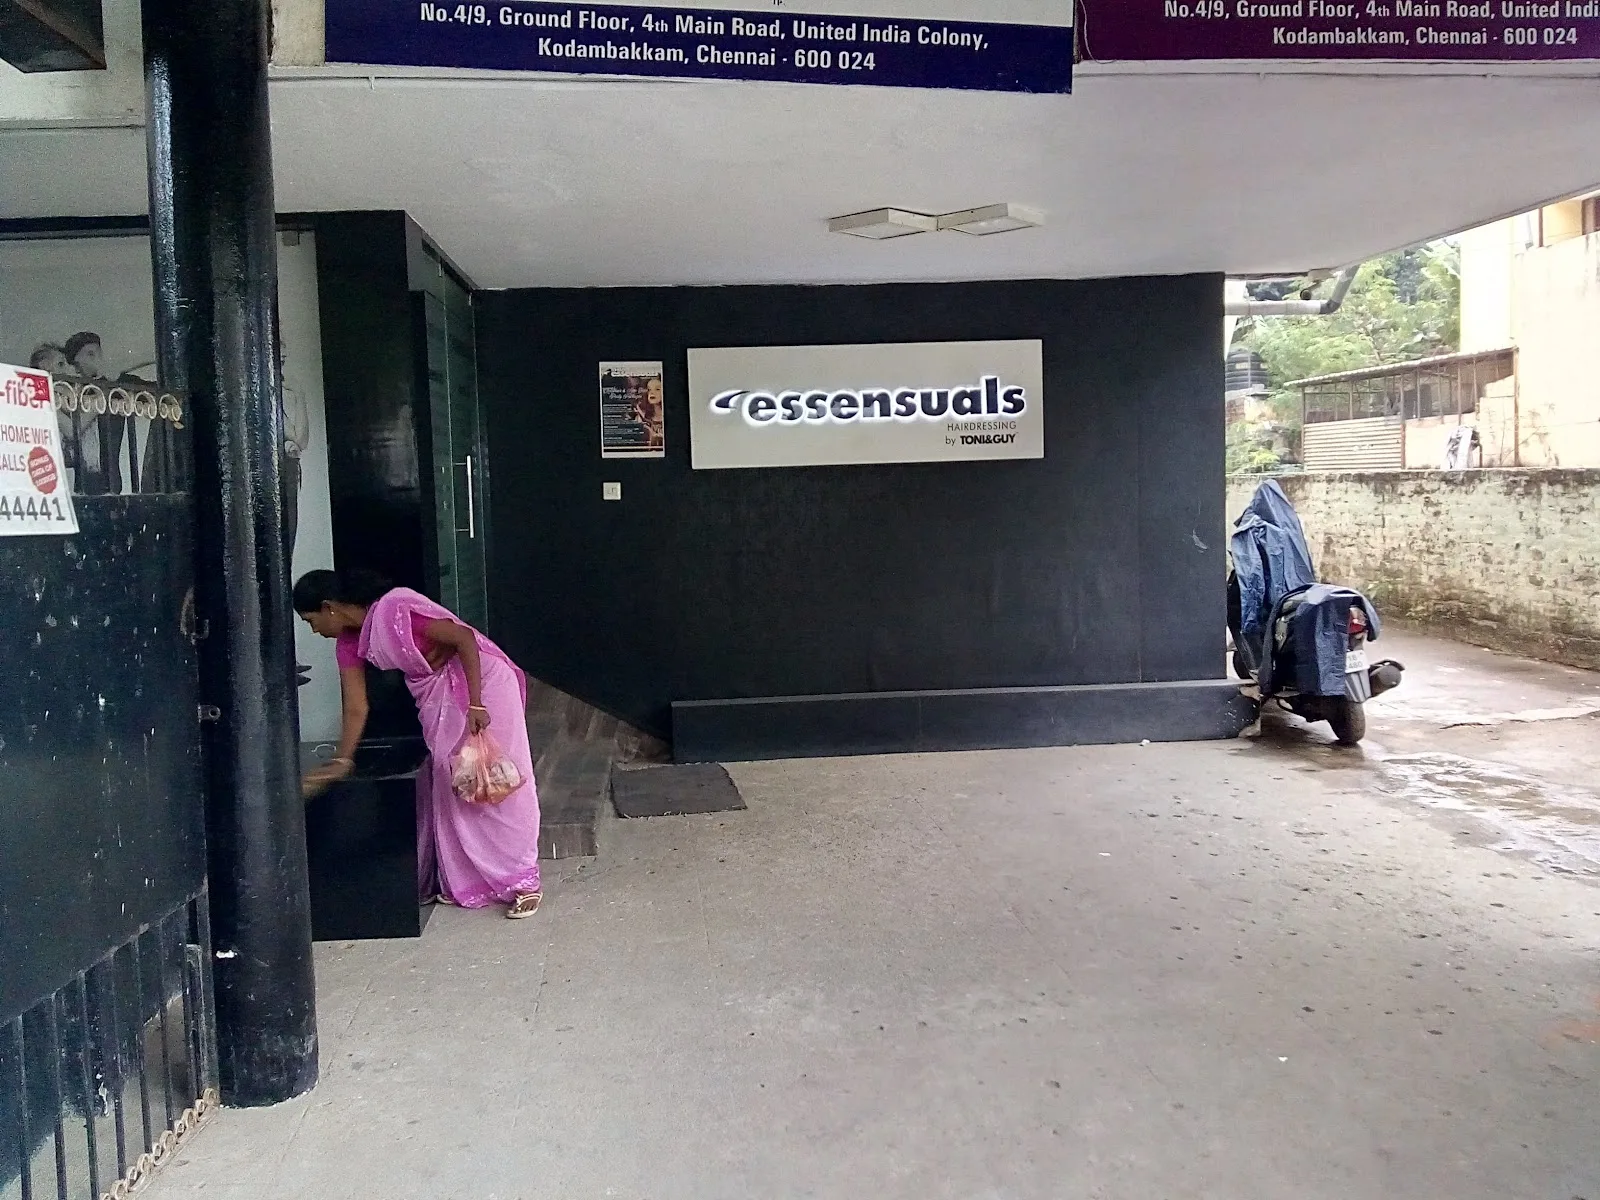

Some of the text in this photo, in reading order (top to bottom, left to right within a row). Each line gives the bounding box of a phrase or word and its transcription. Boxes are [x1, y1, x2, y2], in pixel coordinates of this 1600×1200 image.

[1164, 0, 1600, 20] No.4/9, Ground Floor, 4th Main Road, United Indi
[420, 3, 989, 51] No.4/9, Ground Floor, 4th Main Road, United India Colony,
[1273, 27, 1409, 45] Kodambakkam,
[1416, 27, 1487, 45] Chennai
[1503, 27, 1538, 45] 600
[1543, 27, 1578, 45] 024
[538, 38, 689, 64] Kodambakkam,
[696, 44, 776, 66] Chennai
[794, 49, 831, 69] 600
[838, 52, 875, 70] 024
[747, 376, 1026, 420] essensuals
[1, 424, 30, 444] HOME
[947, 421, 1017, 432] HAIRDRESSING
[945, 433, 1017, 447] by TONI&GUY
[0, 453, 26, 472] ALLS
